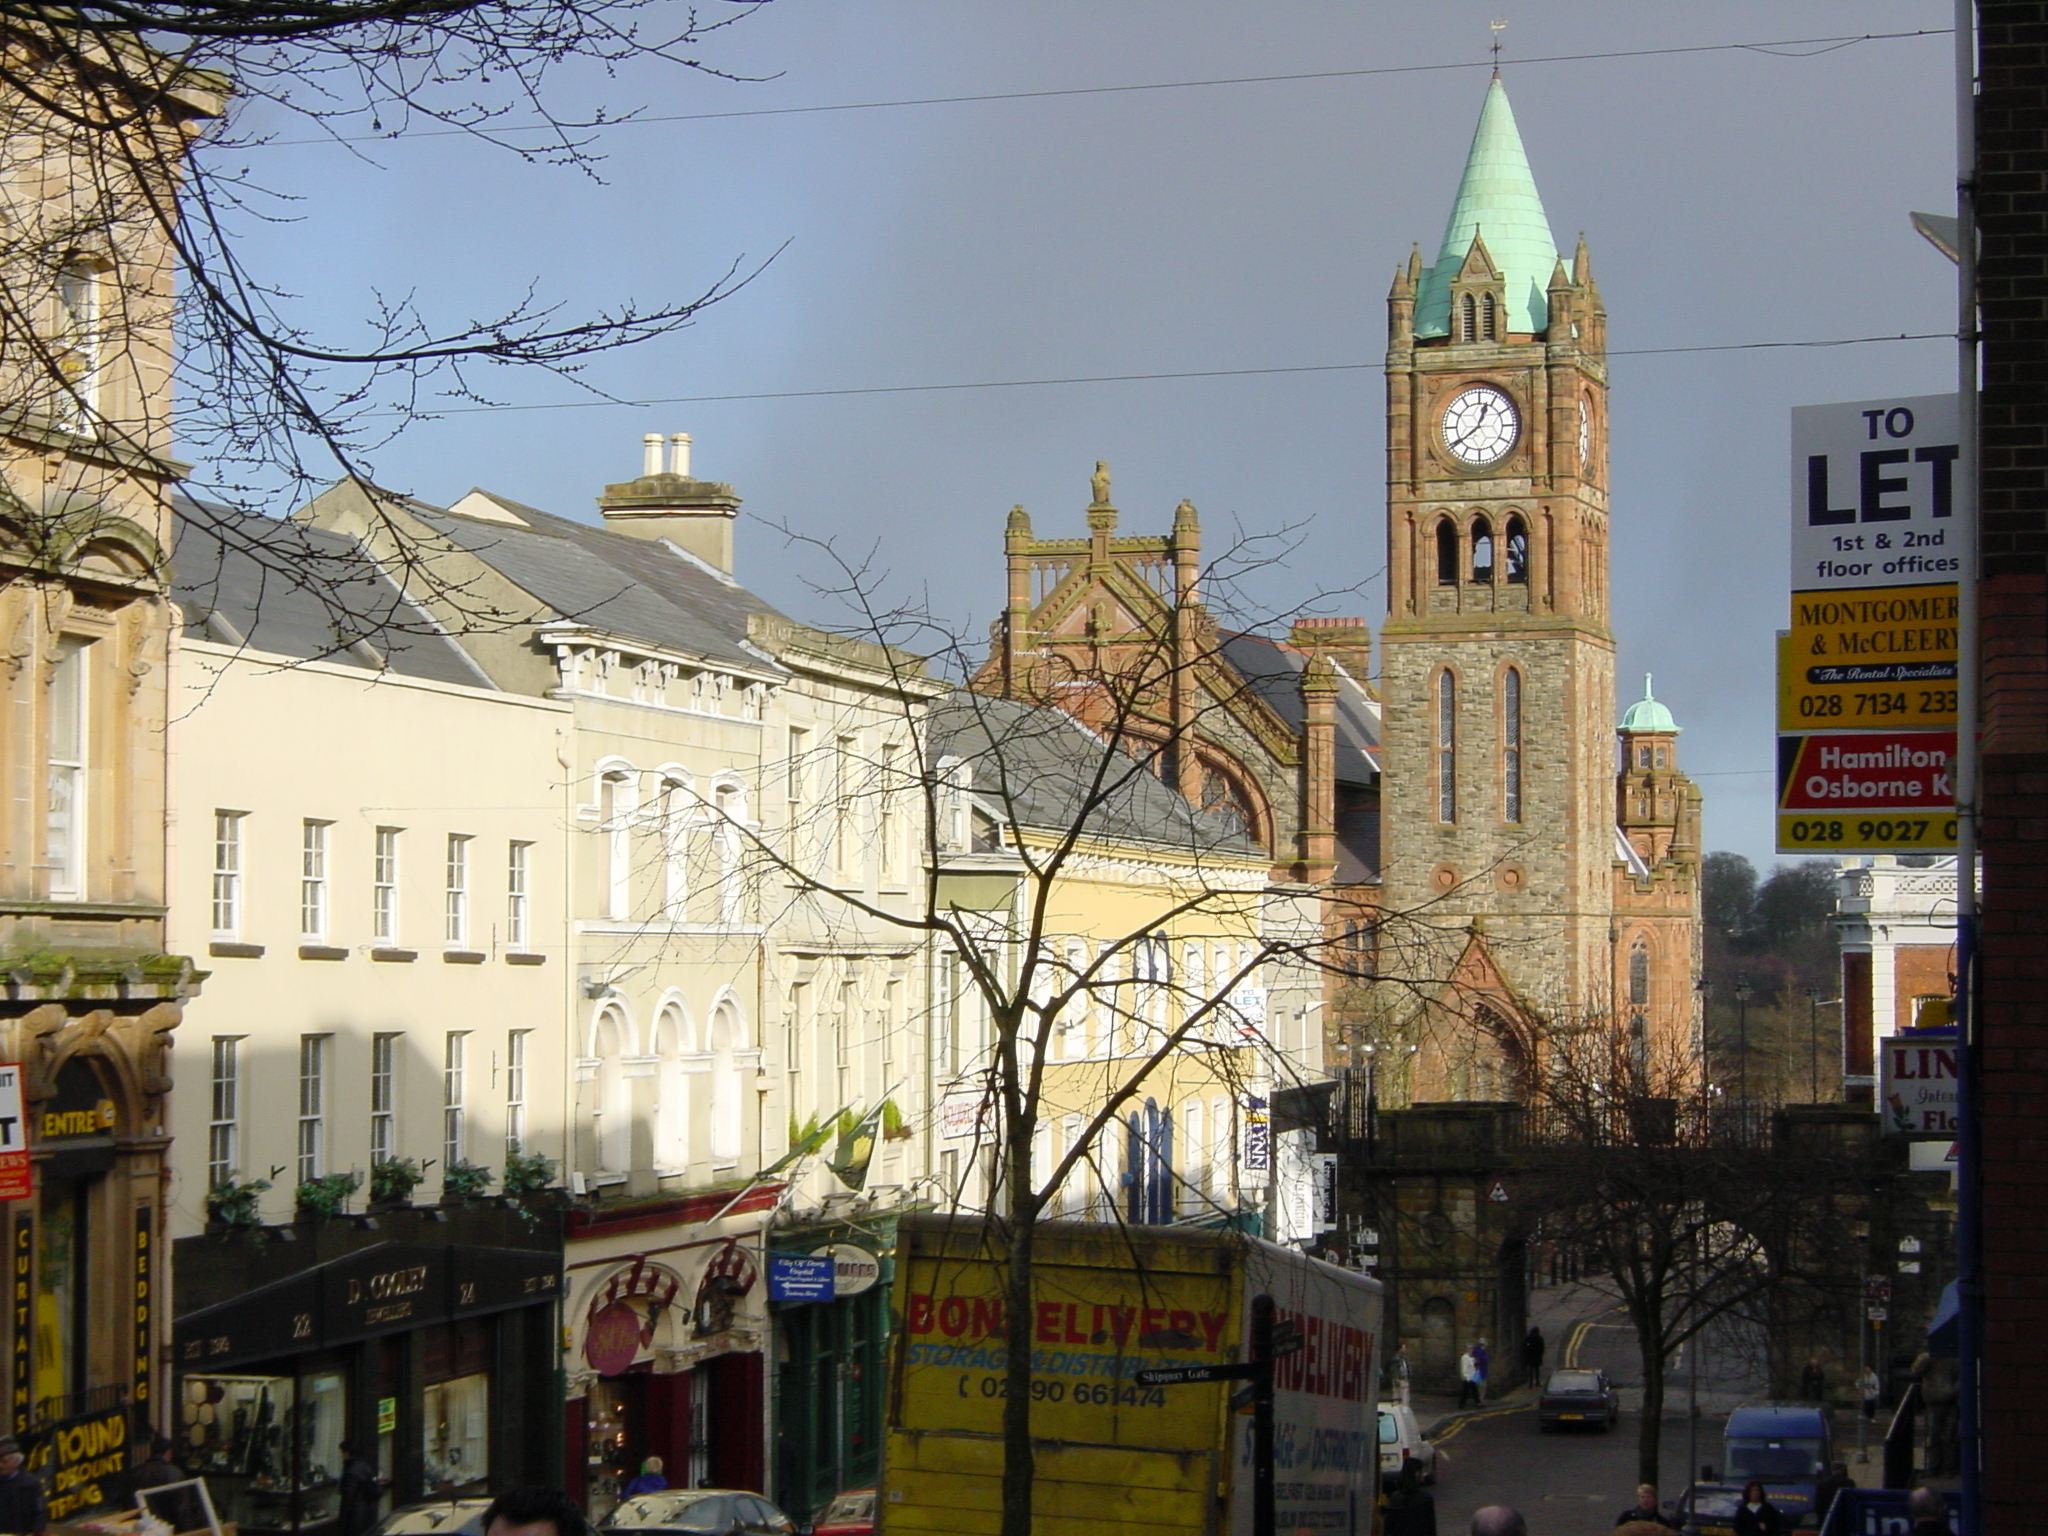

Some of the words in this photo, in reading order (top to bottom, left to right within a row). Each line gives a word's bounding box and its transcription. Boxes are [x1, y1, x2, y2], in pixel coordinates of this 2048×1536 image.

[1862, 407, 1914, 440] TO
[1808, 444, 1959, 526] LET
[1832, 535, 1864, 551] 1st
[1875, 533, 1891, 549] &
[1904, 529, 1944, 547] 2nd
[1817, 561, 1872, 577] floor
[1883, 555, 1959, 573] offices
[1811, 633, 1827, 655] &
[1847, 666, 1888, 680] Rental
[1801, 695, 1842, 717] 028
[1854, 692, 1907, 715] 7134
[1821, 744, 1945, 769] Hamilton
[1806, 775, 1922, 798] Osborne
[1792, 821, 1843, 842] 028
[1858, 821, 1928, 842] 9027
[1234, 997, 1261, 1005] LET
[136, 1230, 150, 1401] BEDDING
[292, 1313, 313, 1339] 22
[15, 1228, 31, 1433] CURTAINS
[904, 1343, 1009, 1371] STORAG
[1188, 1368, 1210, 1379] Gate
[1073, 1383, 1165, 1408] 661474
